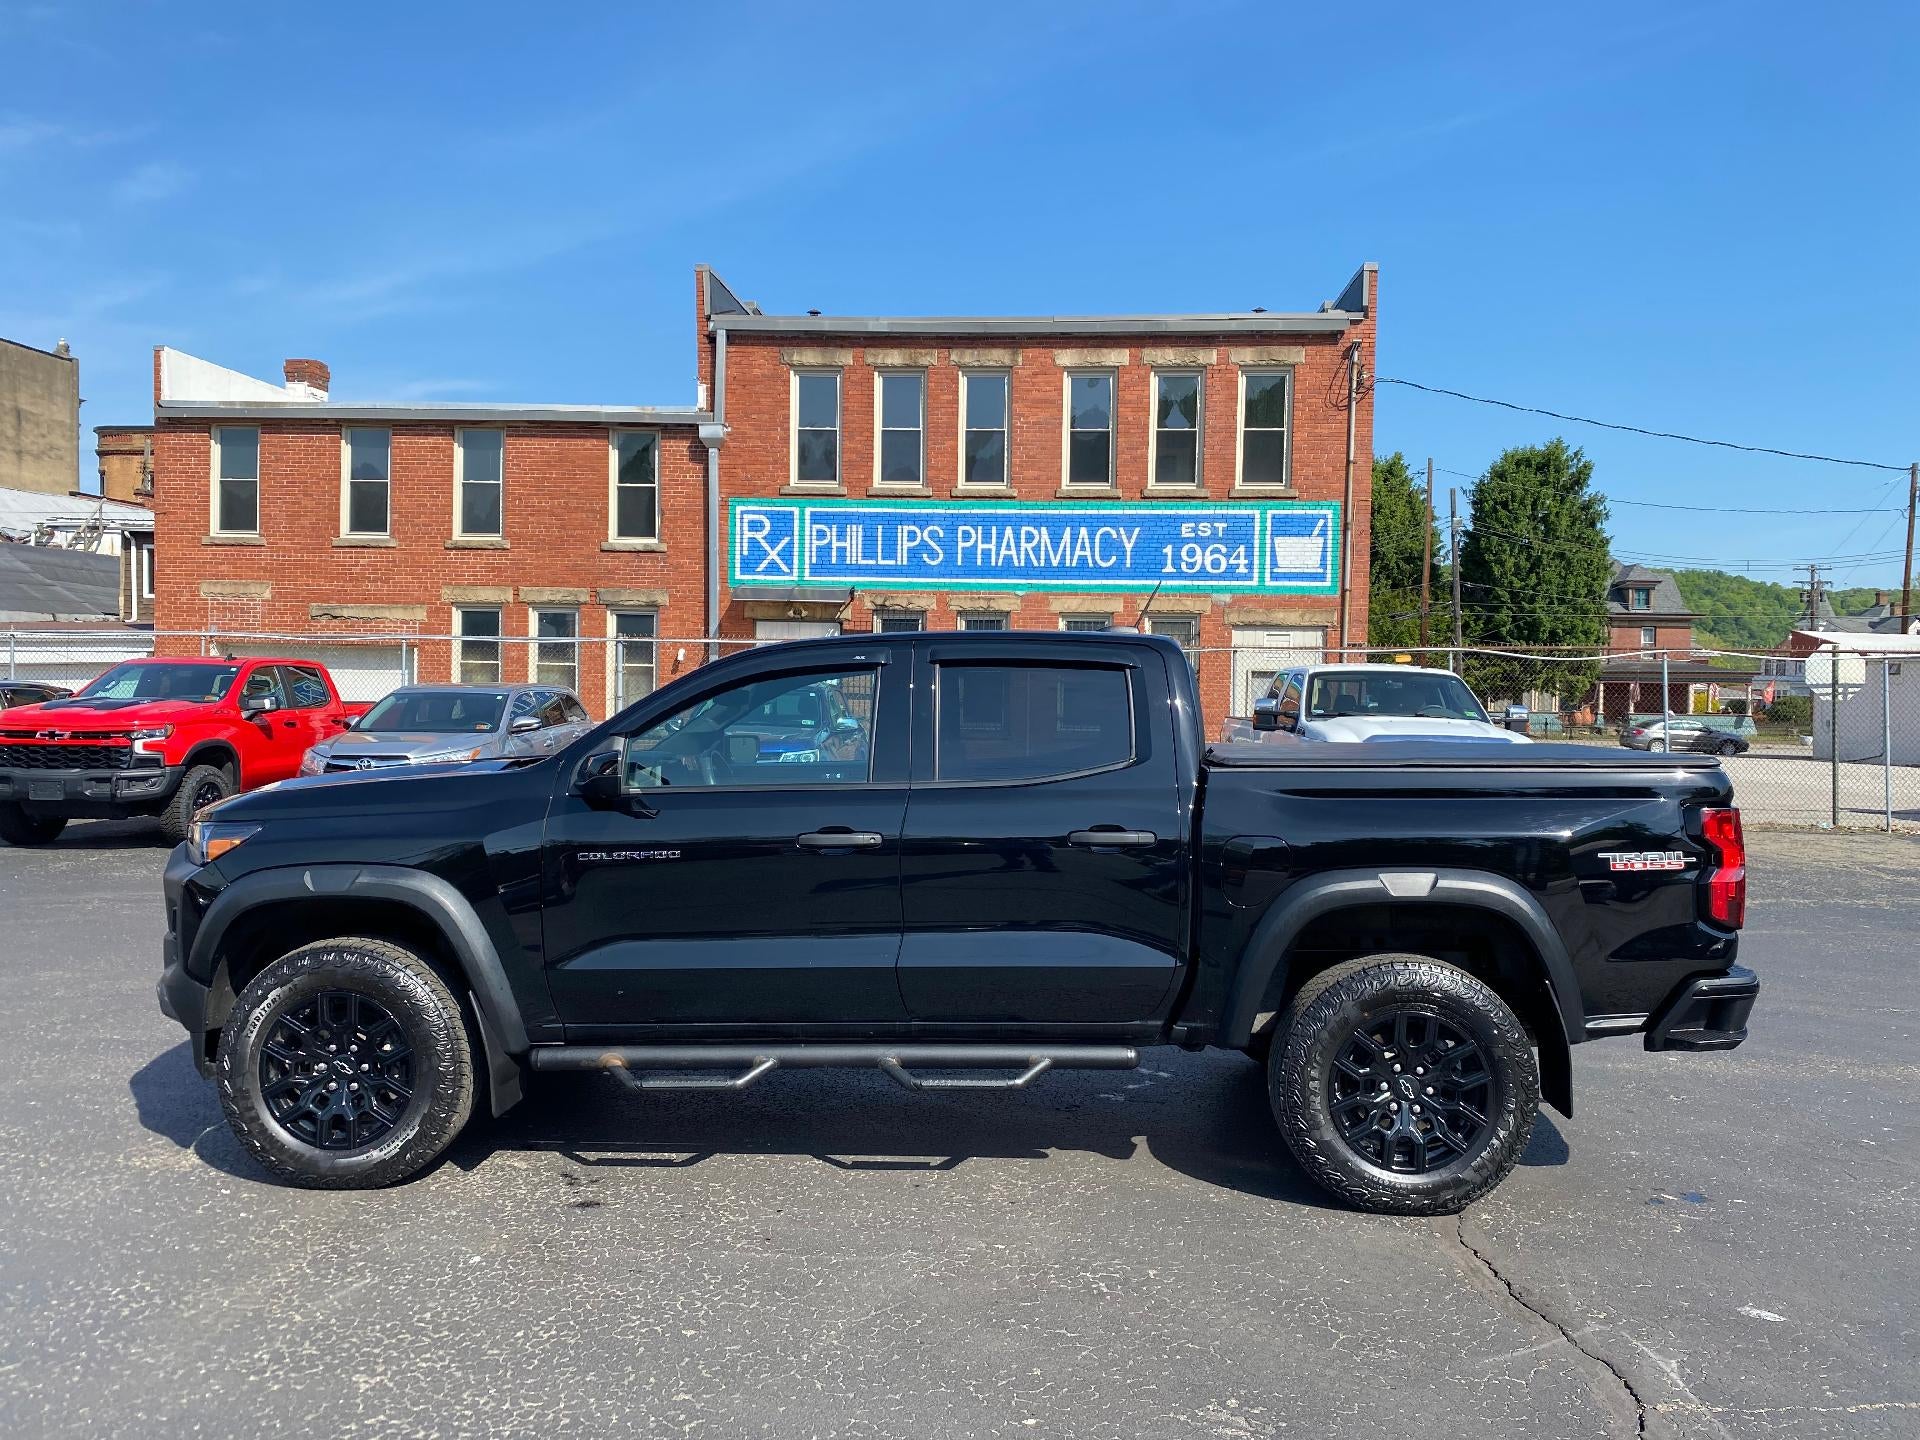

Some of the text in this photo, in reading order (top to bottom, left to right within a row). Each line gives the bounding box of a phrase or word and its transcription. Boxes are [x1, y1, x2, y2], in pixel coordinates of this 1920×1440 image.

[1180, 522, 1228, 538] EST
[811, 524, 1141, 568] PHILLIPS PHARMACY
[1161, 543, 1249, 574] 1964
[578, 851, 680, 860] COLORADO
[1598, 852, 1696, 862] TRAIL
[1611, 861, 1684, 870] BOSS
